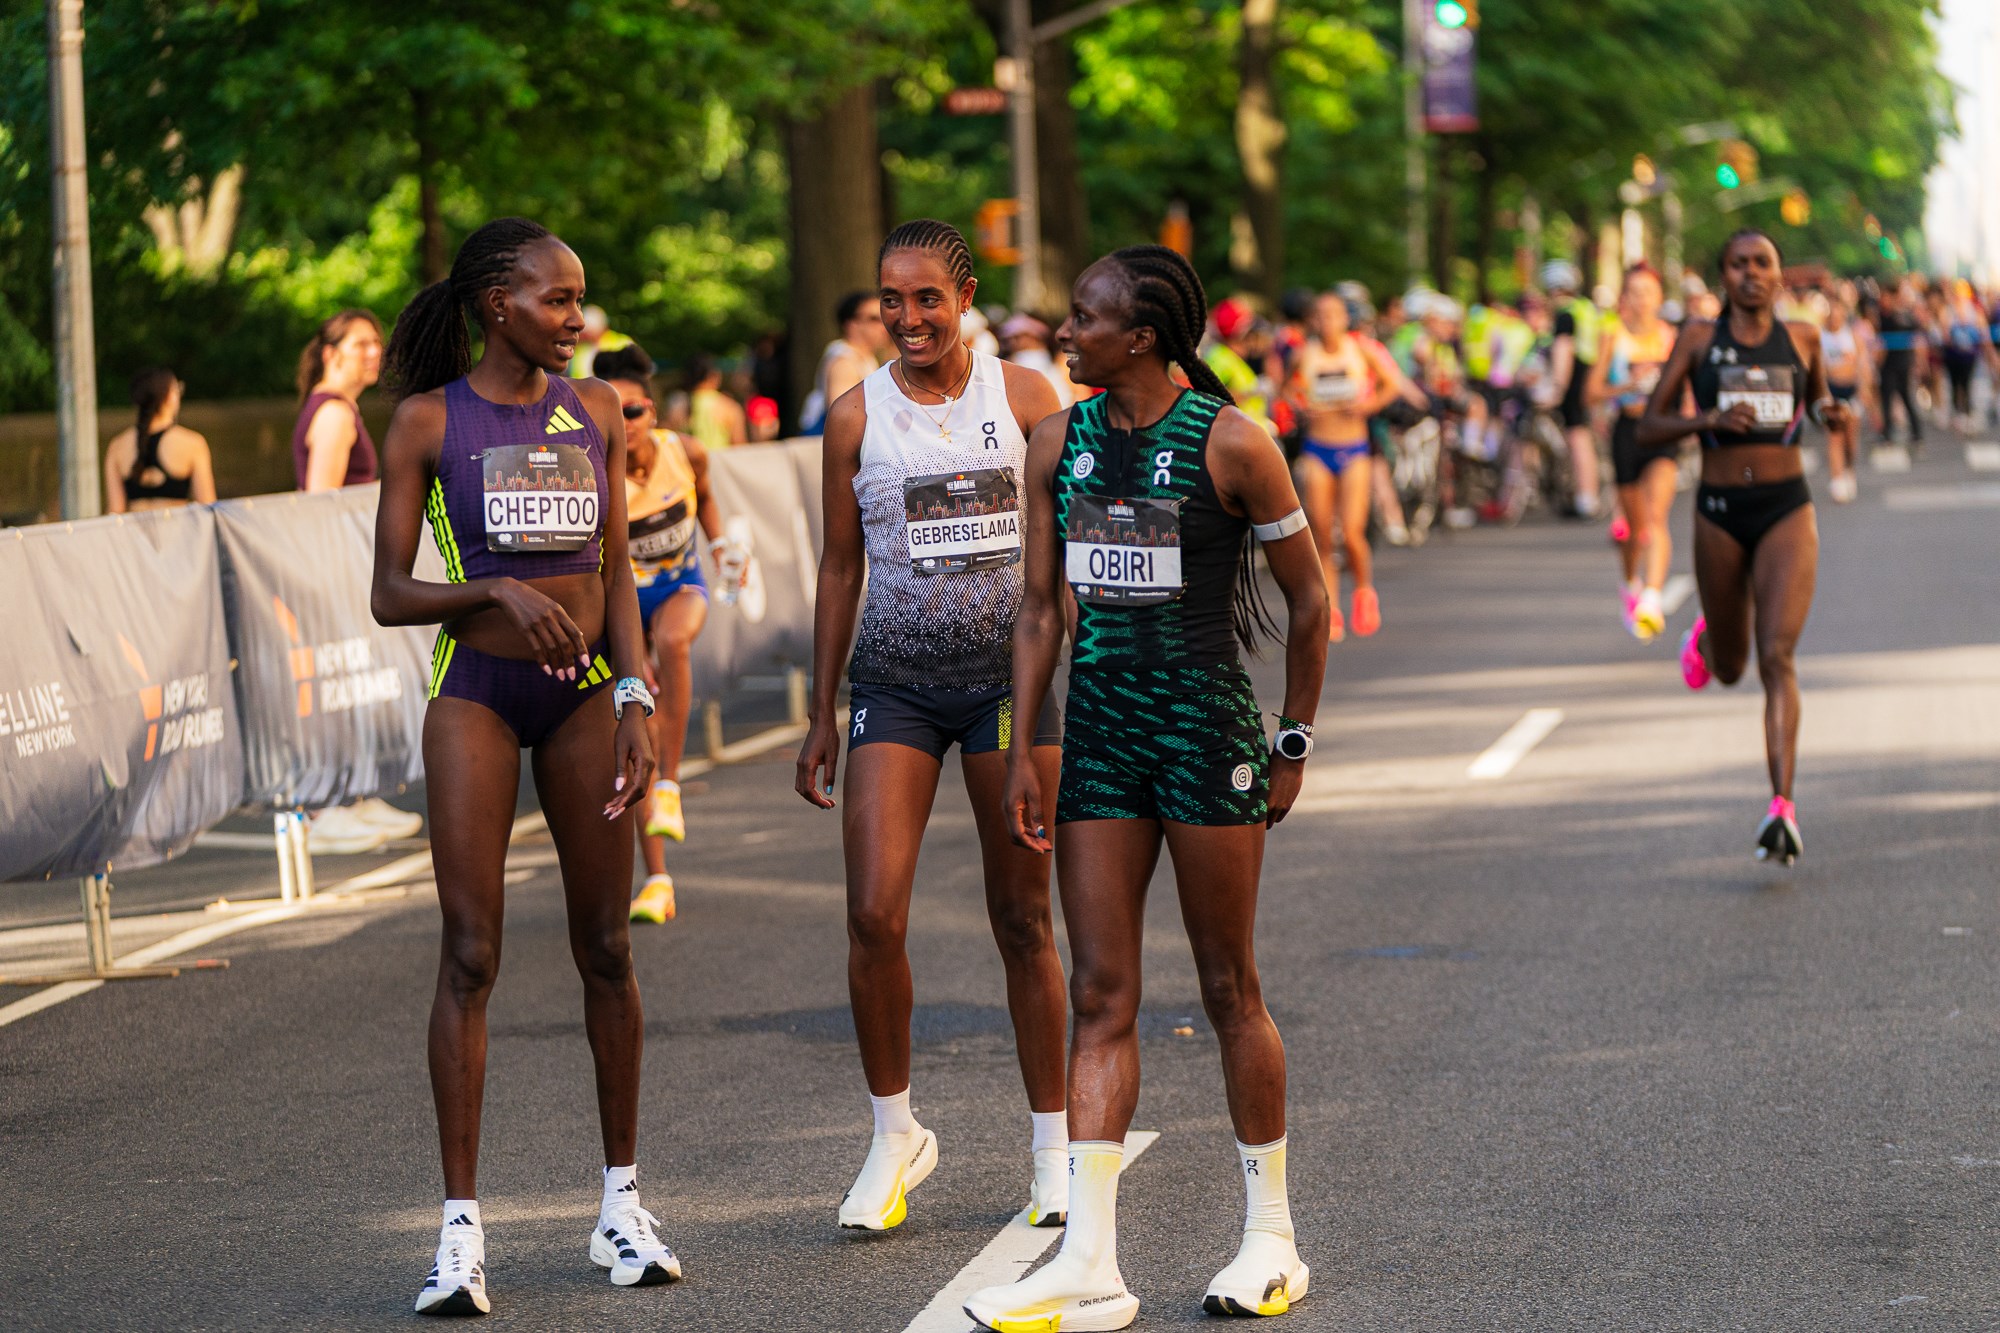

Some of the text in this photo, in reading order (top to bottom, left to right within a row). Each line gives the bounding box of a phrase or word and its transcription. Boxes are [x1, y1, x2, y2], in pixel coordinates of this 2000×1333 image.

[488, 496, 596, 526] CHEPTOO
[911, 518, 1017, 546] GEBRESELAMA
[1089, 548, 1154, 582] OBIRI
[16, 723, 76, 758] NEW YORK
[1079, 1291, 1126, 1307] ON RUNNING
